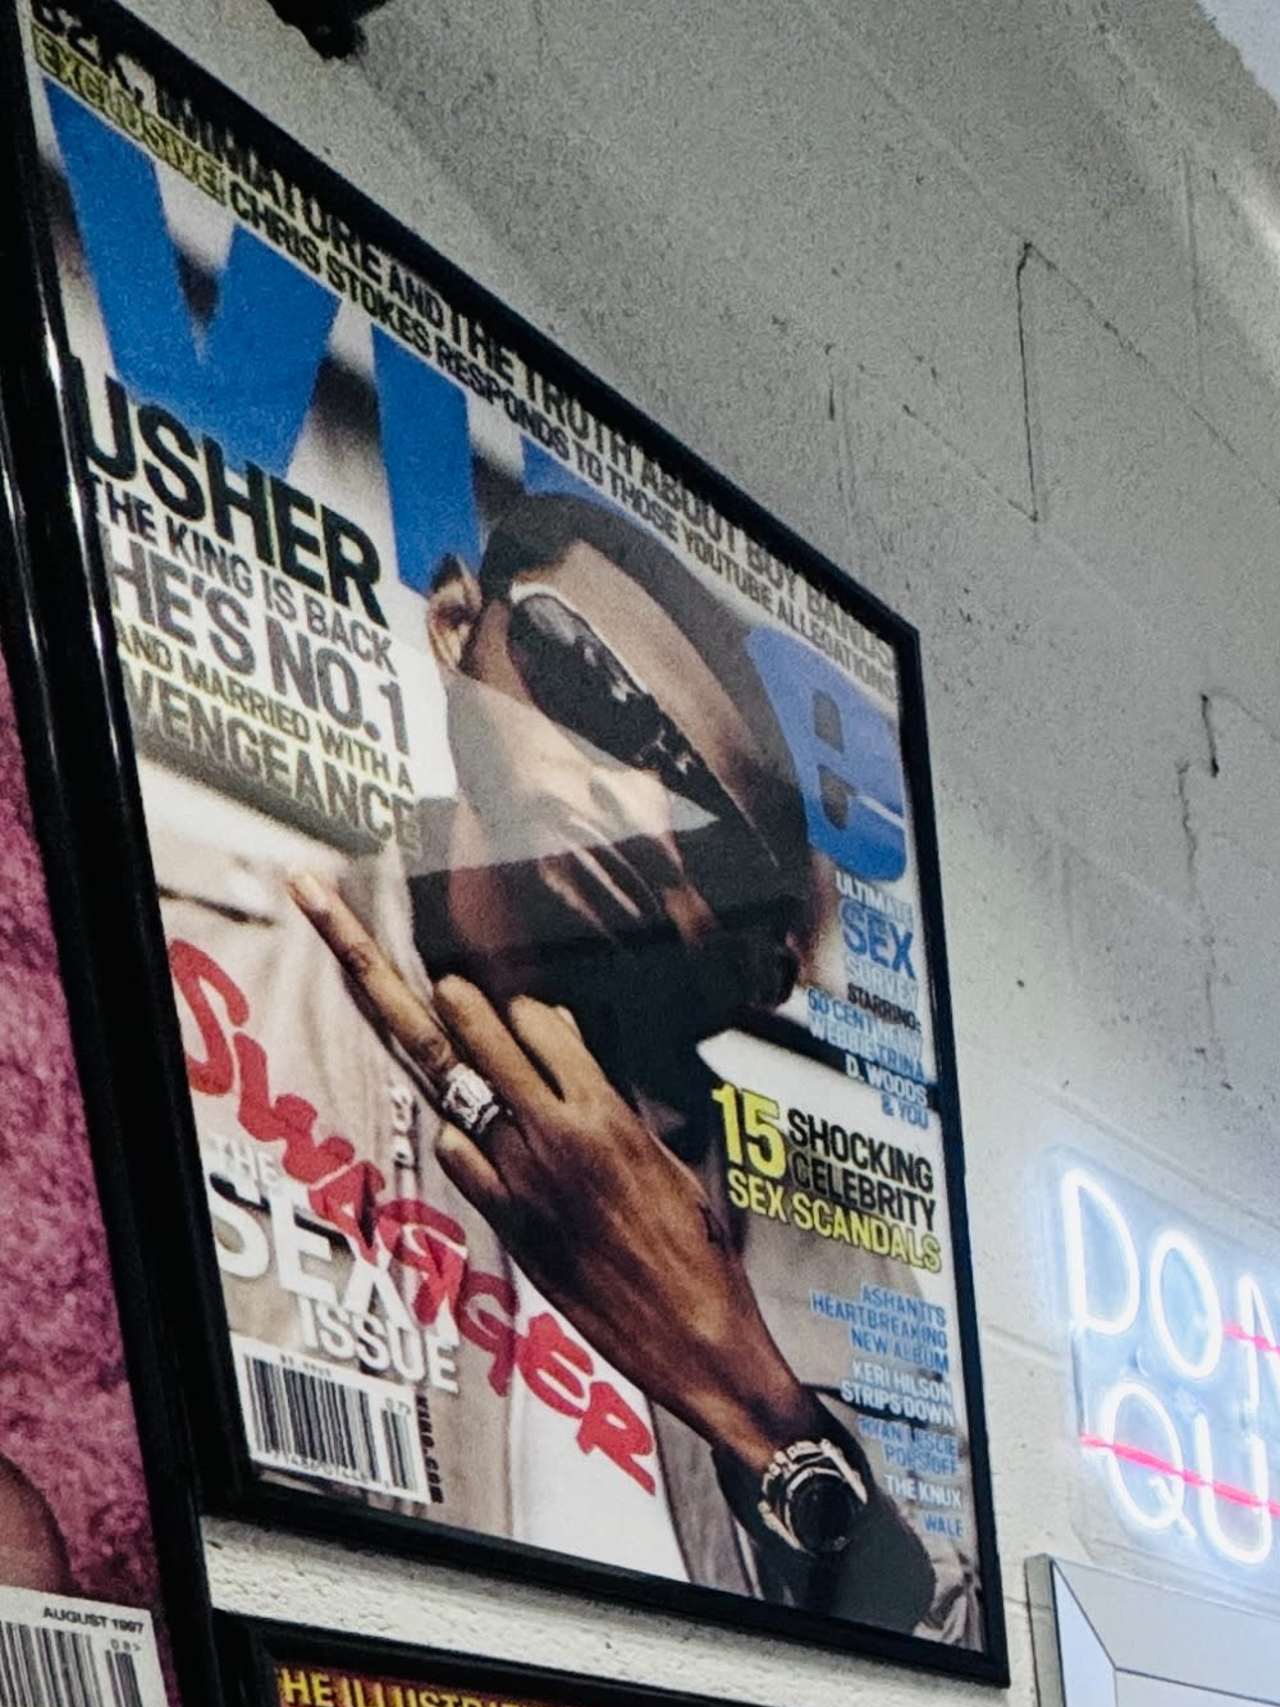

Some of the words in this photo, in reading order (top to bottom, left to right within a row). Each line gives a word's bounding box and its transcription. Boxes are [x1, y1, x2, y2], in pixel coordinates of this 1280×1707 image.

[228, 180, 323, 277] CHRIS
[326, 258, 432, 358] STOKES
[435, 342, 571, 463] RESPONDS
[607, 461, 680, 547] THOSE
[684, 518, 775, 619] YOUTUBE
[68, 357, 390, 629] USHER
[102, 522, 257, 677] HE'S
[164, 514, 254, 599] KING
[261, 570, 297, 621] IS
[303, 597, 398, 676] BACK
[120, 657, 423, 864] VENGEANCE
[177, 652, 311, 745] MARRIED
[316, 718, 391, 781] WITH
[398, 761, 414, 796] A
[840, 900, 916, 981] SEX
[712, 1081, 787, 1180] 15
[866, 1059, 928, 1106] WOODS
[786, 1107, 934, 1195] SHOCKING
[791, 1149, 937, 1233] CELEBRITY
[203, 1170, 412, 1332] SEX
[726, 1170, 789, 1225] SEX
[791, 1192, 943, 1275] SCANDALS
[298, 1296, 461, 1396] ISSUE
[851, 1327, 889, 1356] NEW
[43, 1606, 109, 1630] AUGUST
